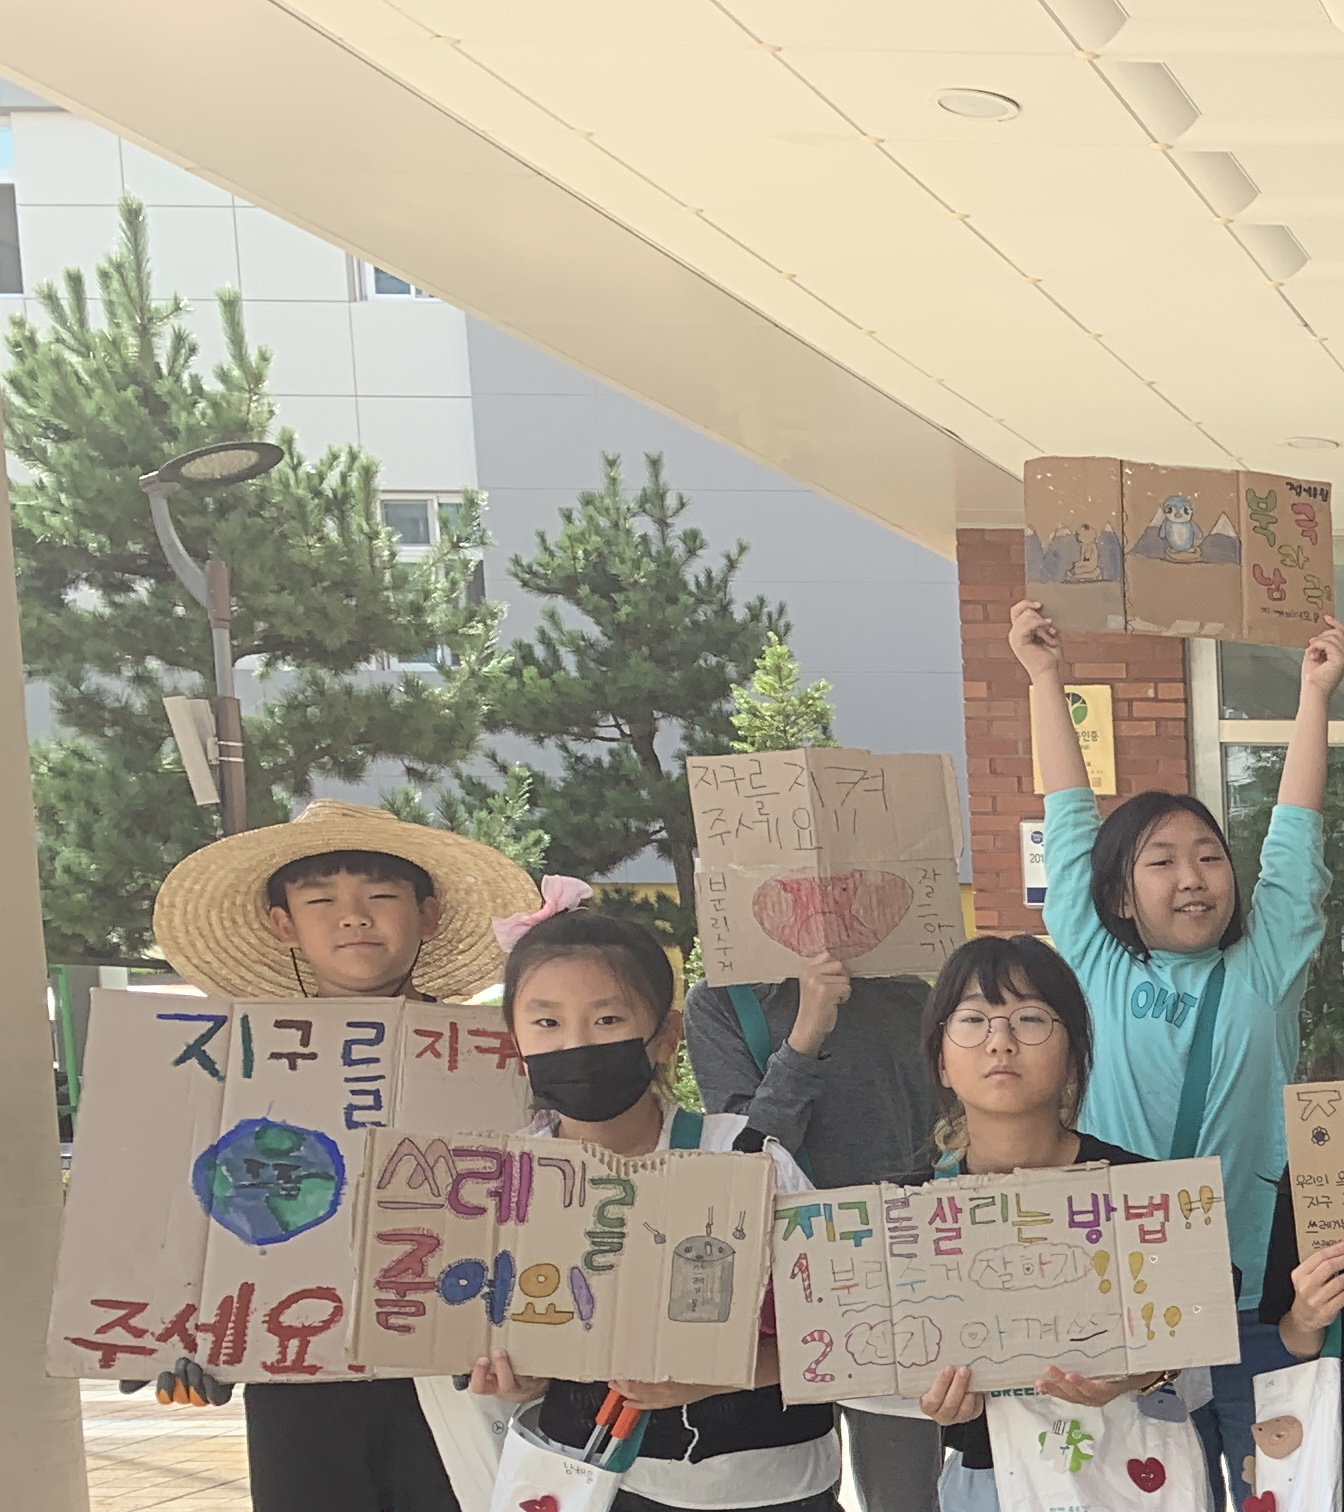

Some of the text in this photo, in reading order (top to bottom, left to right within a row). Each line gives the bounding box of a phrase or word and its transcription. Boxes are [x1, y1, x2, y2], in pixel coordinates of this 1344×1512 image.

[784, 761, 888, 811] 지켜
[156, 1012, 386, 1130] 지구를
[375, 1136, 638, 1276] 쓰레기를
[775, 1197, 919, 1259] 지구를
[928, 1191, 1055, 1257] 살리는
[990, 1387, 1047, 1398] GREE
